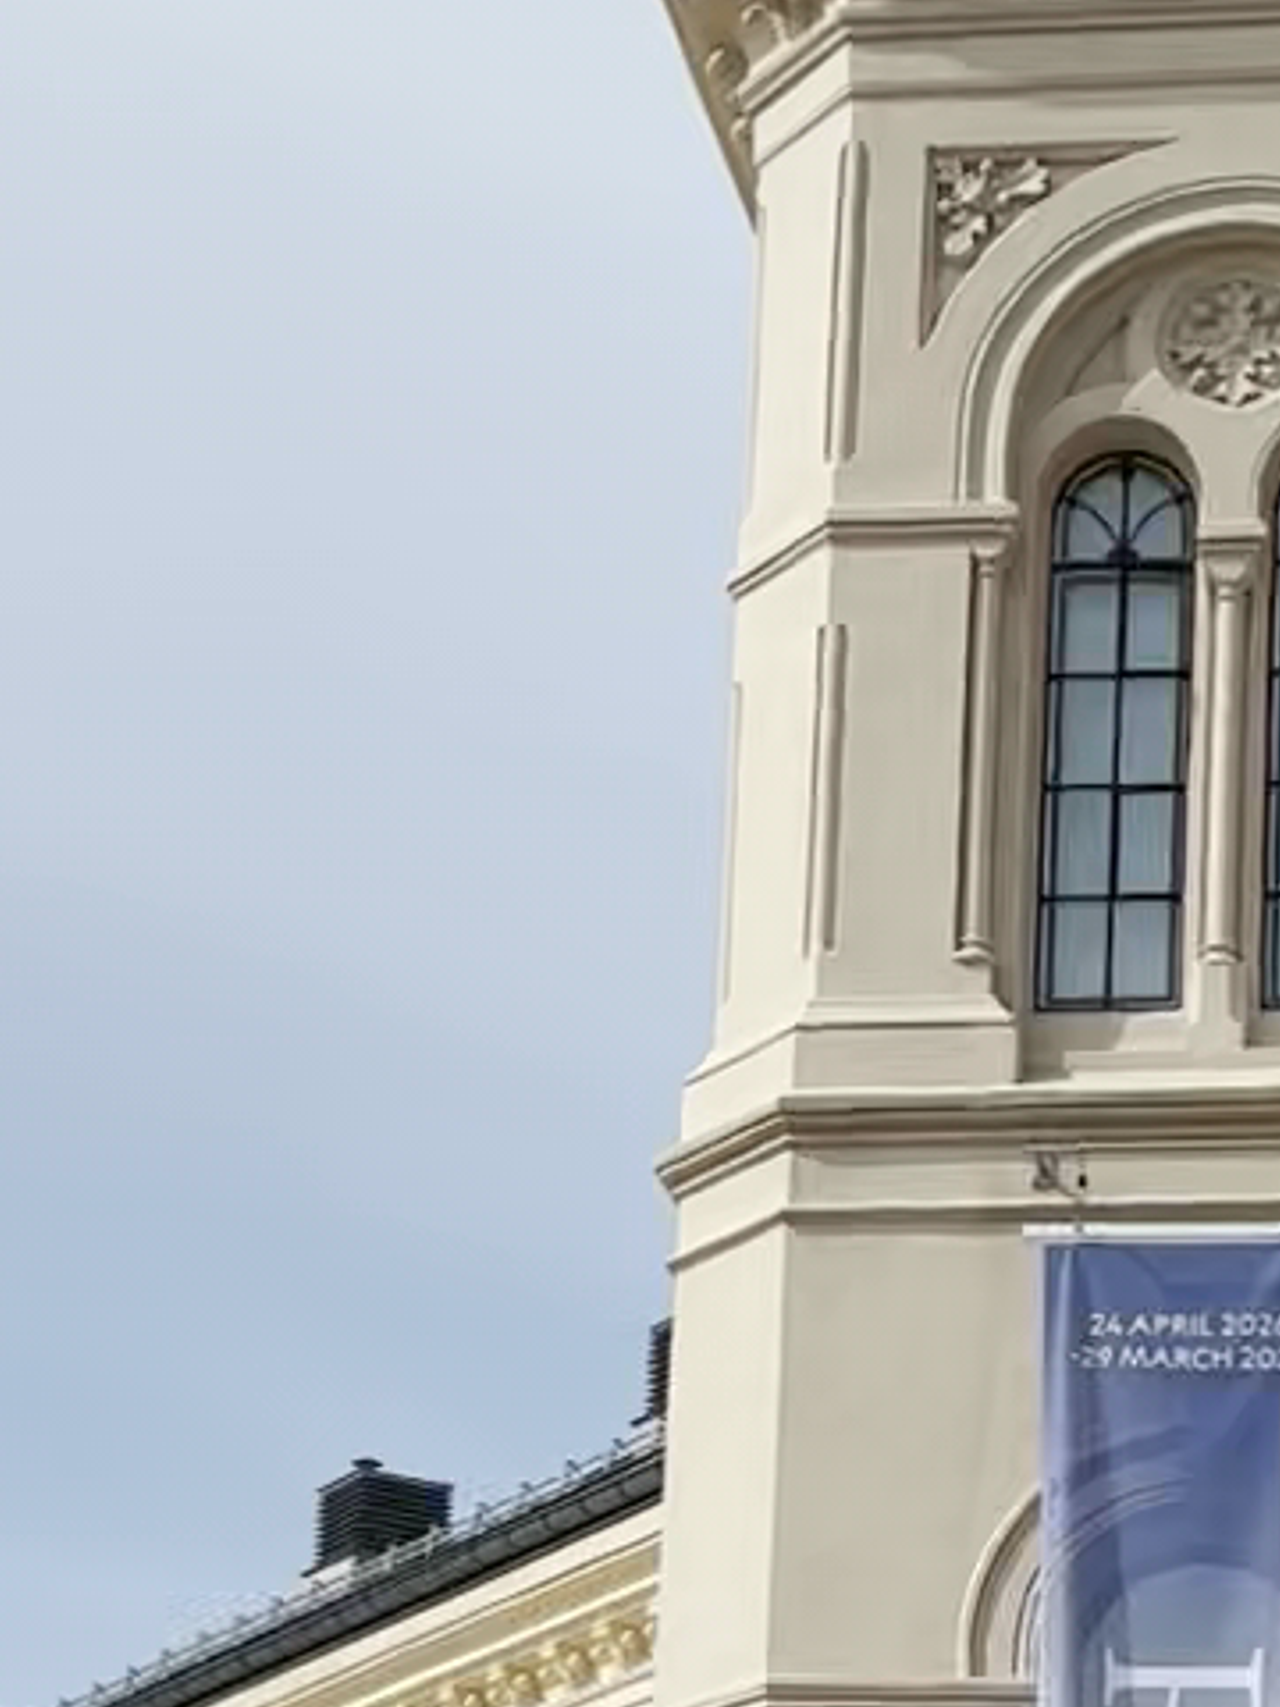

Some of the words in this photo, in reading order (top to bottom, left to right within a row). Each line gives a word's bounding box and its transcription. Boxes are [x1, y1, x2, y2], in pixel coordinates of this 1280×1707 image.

[1090, 1313, 1122, 1336] 24
[1125, 1313, 1214, 1336] APRIL
[1119, 1345, 1233, 1370] MARCH
